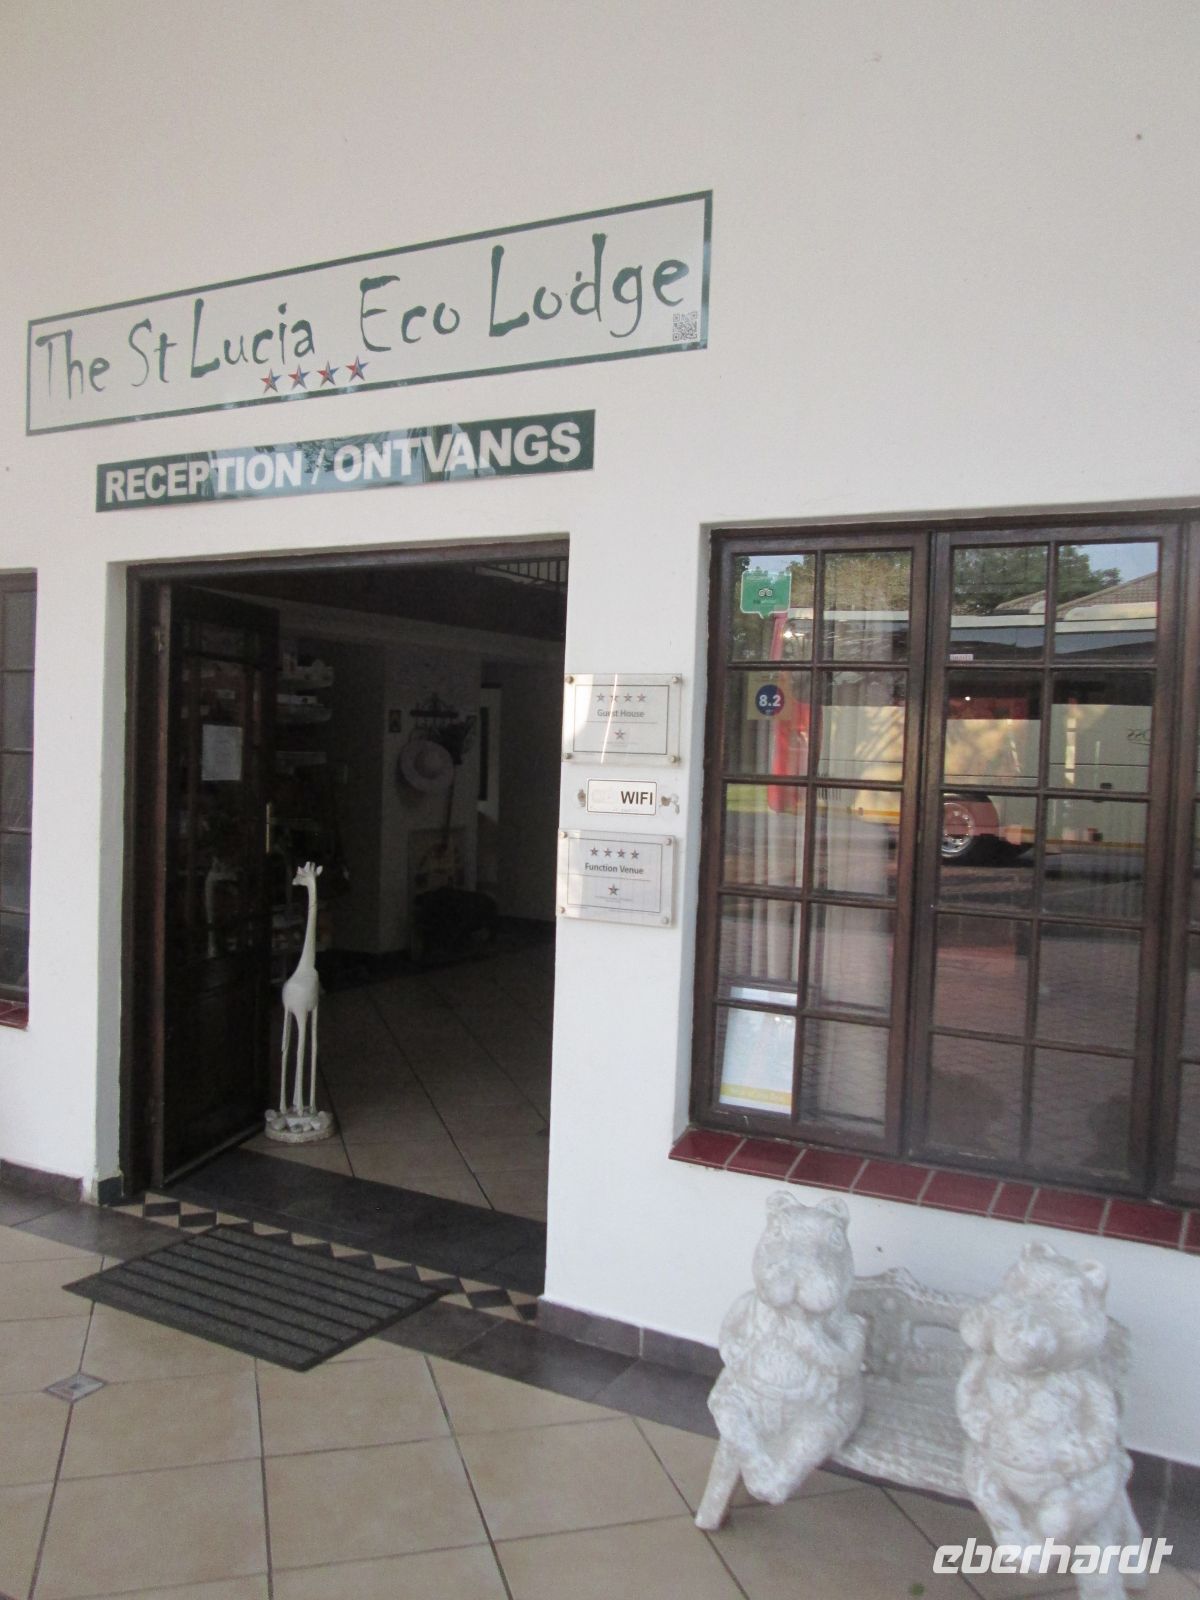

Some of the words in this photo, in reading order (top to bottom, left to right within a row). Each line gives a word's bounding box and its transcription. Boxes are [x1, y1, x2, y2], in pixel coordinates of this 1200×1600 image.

[36, 330, 110, 400] The
[128, 318, 177, 388] St
[190, 298, 316, 379] Lucia
[359, 275, 461, 353] Eco
[489, 233, 690, 338] Lodge
[104, 449, 303, 504] RECEPTION
[334, 422, 582, 483] ONTVANGS
[758, 694, 782, 707] 8.2
[620, 709, 645, 718] House
[620, 790, 653, 806] WIFI
[584, 862, 618, 873] Function
[619, 865, 644, 875] Venue
